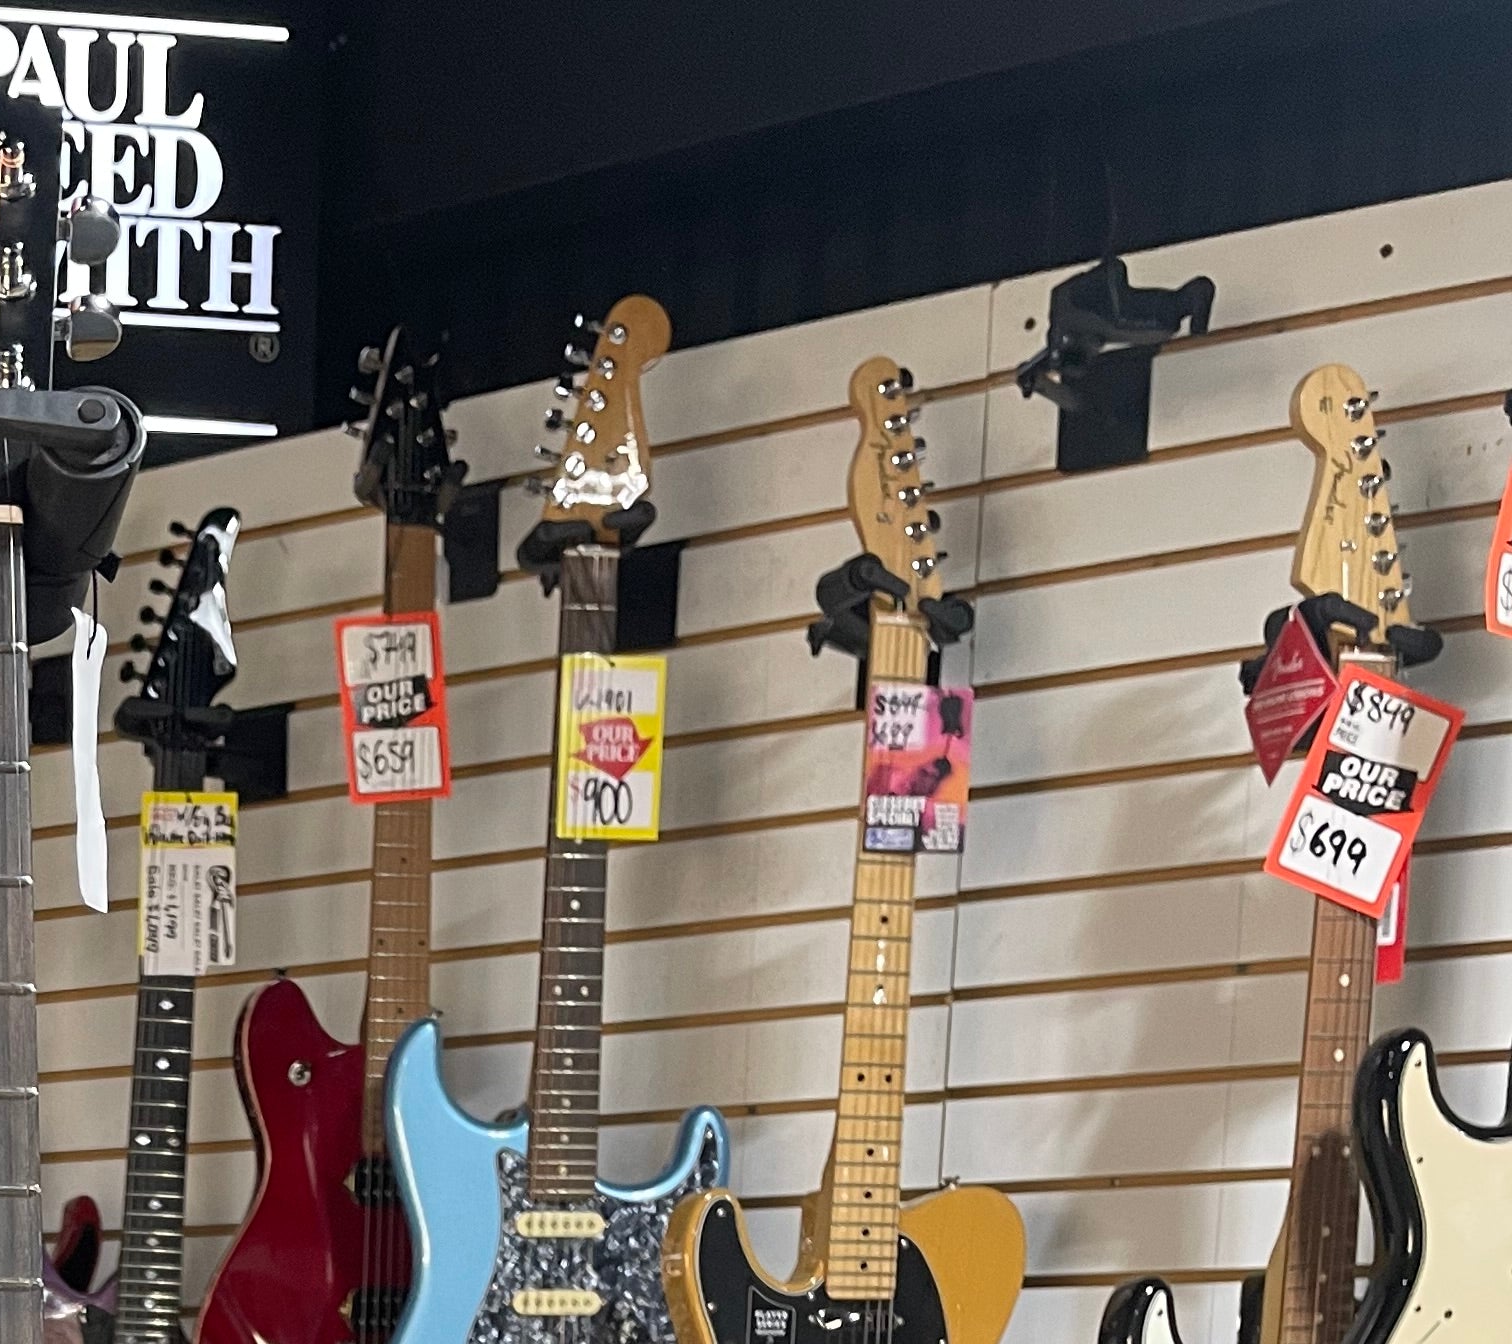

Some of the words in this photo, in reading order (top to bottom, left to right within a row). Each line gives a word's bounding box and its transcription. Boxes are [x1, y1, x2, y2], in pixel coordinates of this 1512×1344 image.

[361, 692, 427, 724] PRICE
[367, 680, 414, 703] OUR
[1346, 681, 1416, 738] $849
[591, 724, 635, 743] OUR
[357, 739, 415, 784] $659
[589, 744, 637, 763] PRICE
[1339, 755, 1400, 789] OUR
[1321, 772, 1408, 812] PRICE
[1289, 811, 1368, 876] $699
